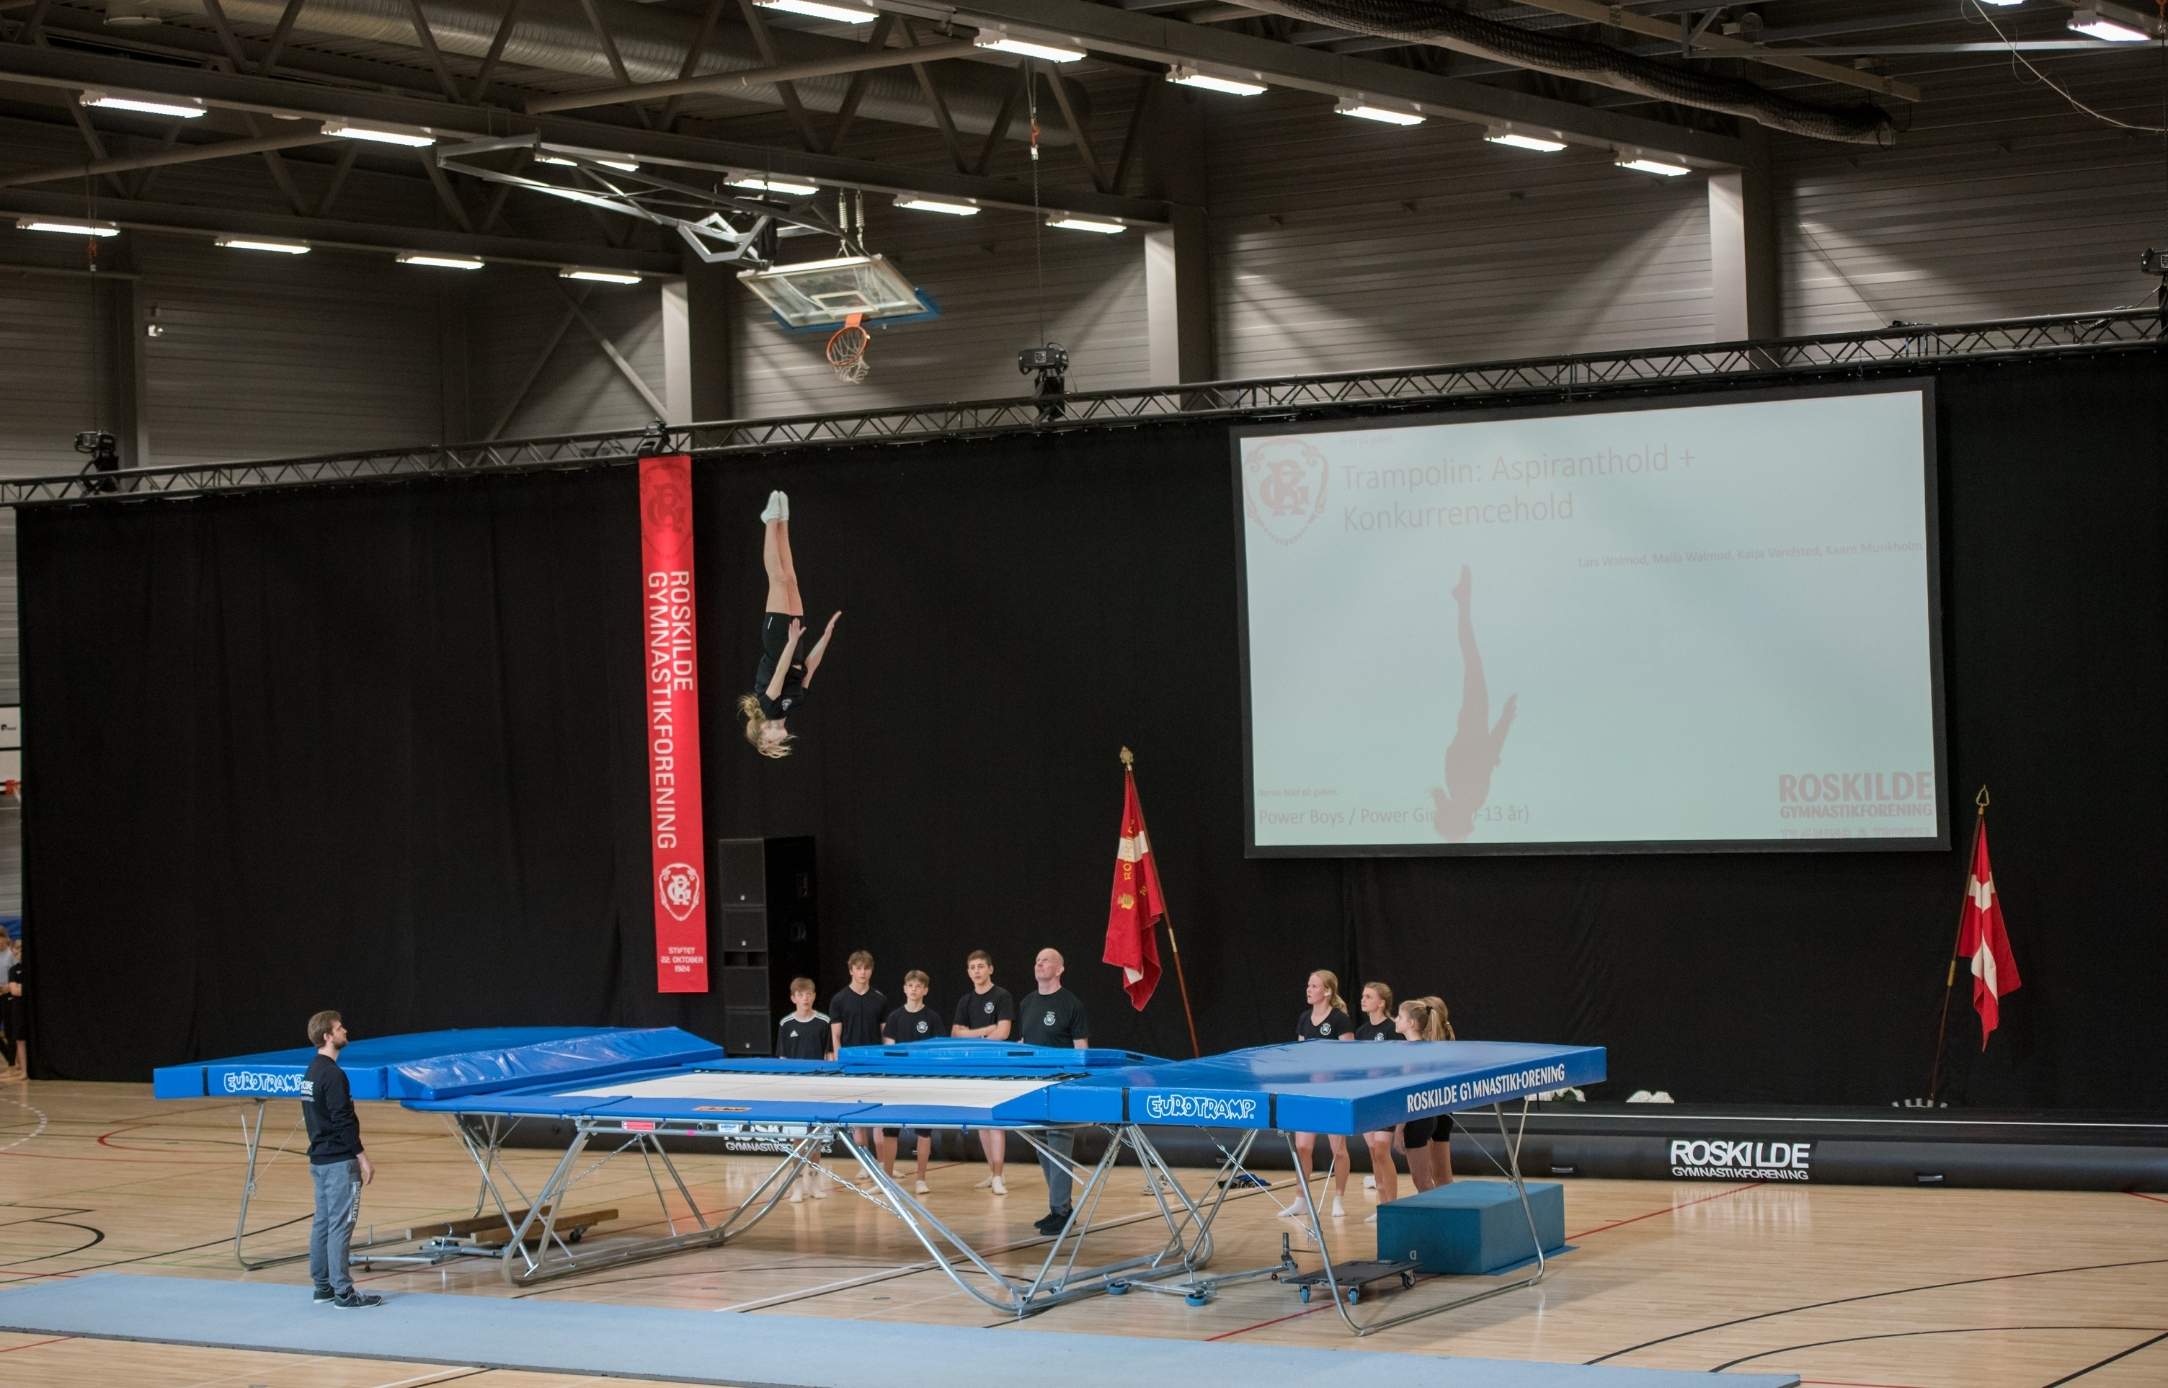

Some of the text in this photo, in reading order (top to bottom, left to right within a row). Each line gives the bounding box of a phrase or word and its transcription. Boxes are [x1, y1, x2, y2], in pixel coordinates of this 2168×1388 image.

[1341, 457, 1482, 492] Trampolin:
[1492, 443, 1669, 486] Aspiranthold
[1343, 491, 1574, 532] Konkurrencehold
[670, 571, 693, 691] ROSKILDE
[648, 571, 677, 848] GYMNASTIKFORENING
[1778, 771, 1932, 803] ROSKILDE
[1259, 808, 1305, 825] Power
[1310, 806, 1345, 828] Boys
[1360, 805, 1408, 824] Power
[1779, 803, 1932, 819] GYMNASTIKFORENING
[1146, 1094, 1256, 1120] EUROTRAMP
[1407, 1085, 1457, 1113] ROSKILDE
[1670, 1140, 1810, 1169] ROSKILDE
[1671, 1167, 1809, 1180] GYMNASTIKFORENING
